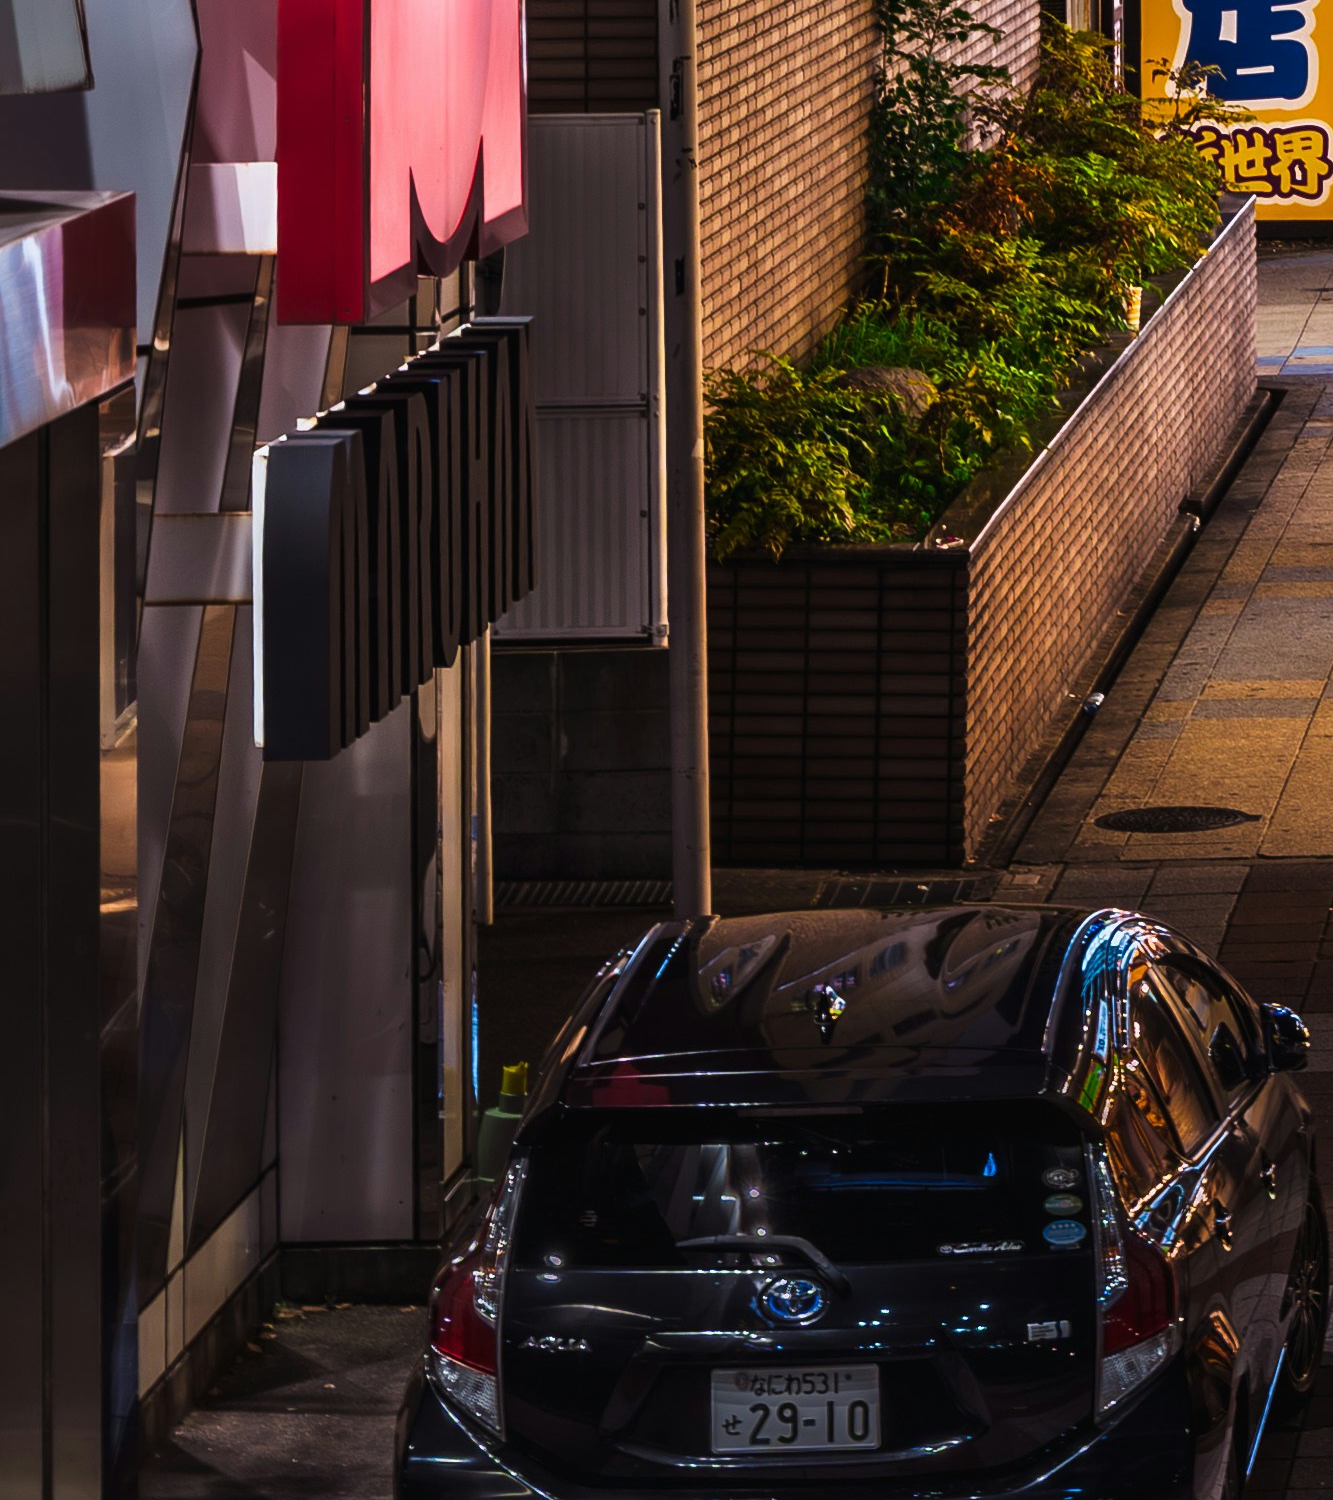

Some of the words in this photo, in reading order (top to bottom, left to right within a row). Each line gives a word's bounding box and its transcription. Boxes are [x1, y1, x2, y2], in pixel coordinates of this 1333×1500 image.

[750, 1374, 800, 1396] なにわ
[802, 1372, 838, 1395] 531
[721, 1414, 743, 1436] せ
[748, 1399, 870, 1446] 29-10
